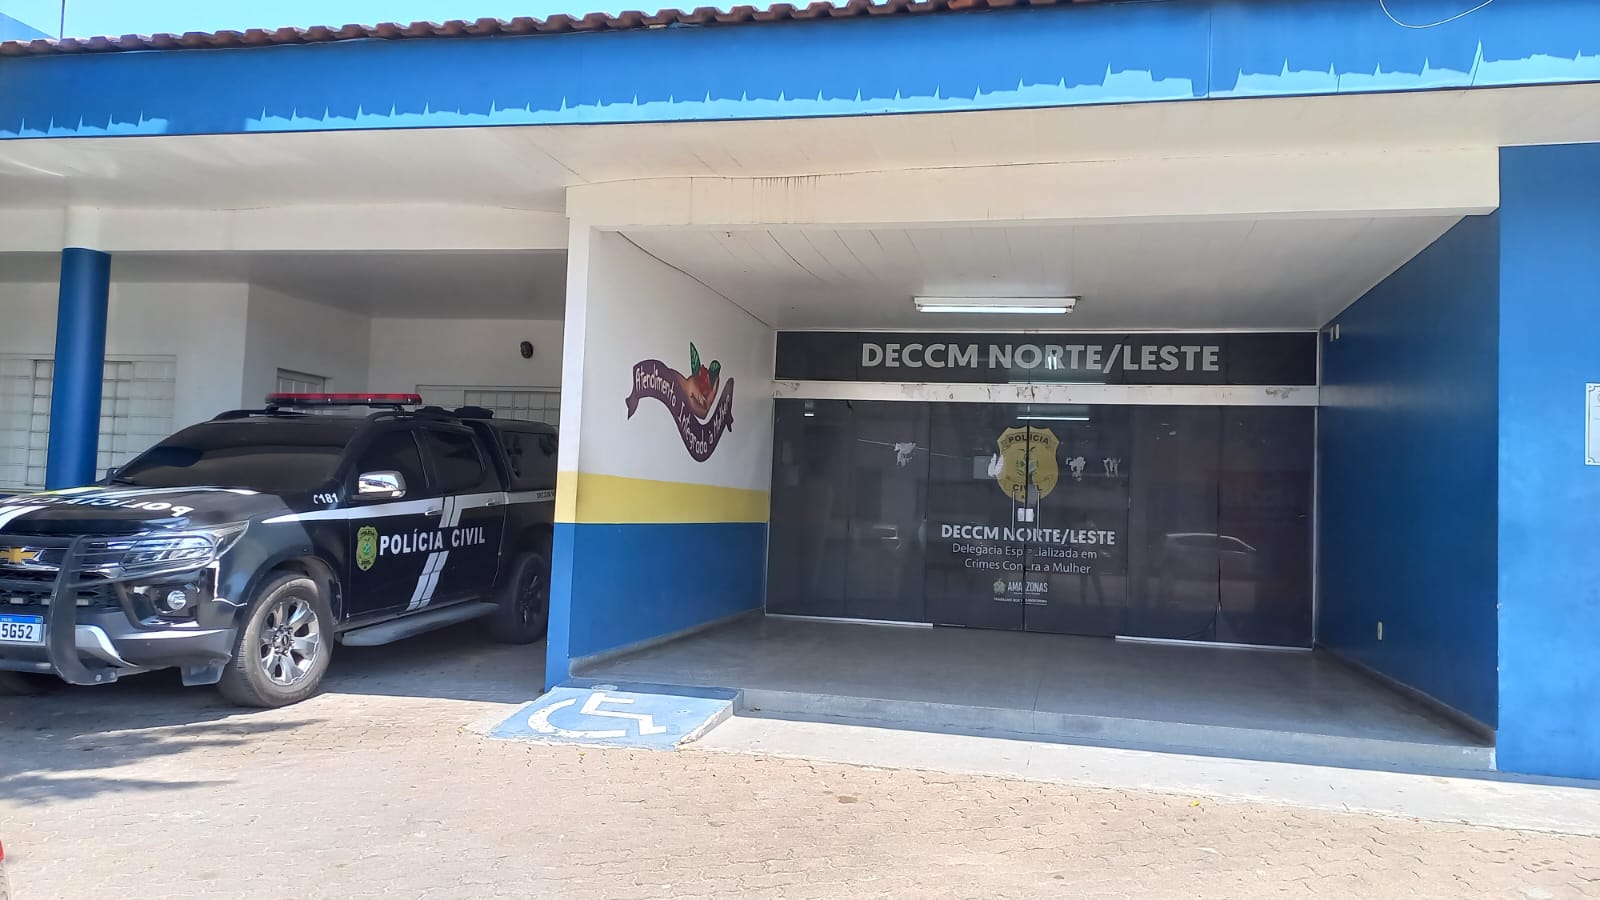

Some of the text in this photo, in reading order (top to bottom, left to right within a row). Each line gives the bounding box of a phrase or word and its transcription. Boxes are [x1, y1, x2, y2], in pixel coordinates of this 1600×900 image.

[861, 343, 1220, 374] DECCM NORTE/LESTE
[635, 363, 677, 408] Atendimento
[941, 524, 999, 541] DECCM
[380, 527, 485, 556] POLÍCIA CIVIL
[952, 543, 1003, 555] Delegacia
[1081, 550, 1098, 559] em
[964, 558, 1000, 570] Crimes
[1043, 564, 1050, 573] a
[1052, 563, 1092, 574] Mulher
[1007, 581, 1048, 593] AMAZONAS
